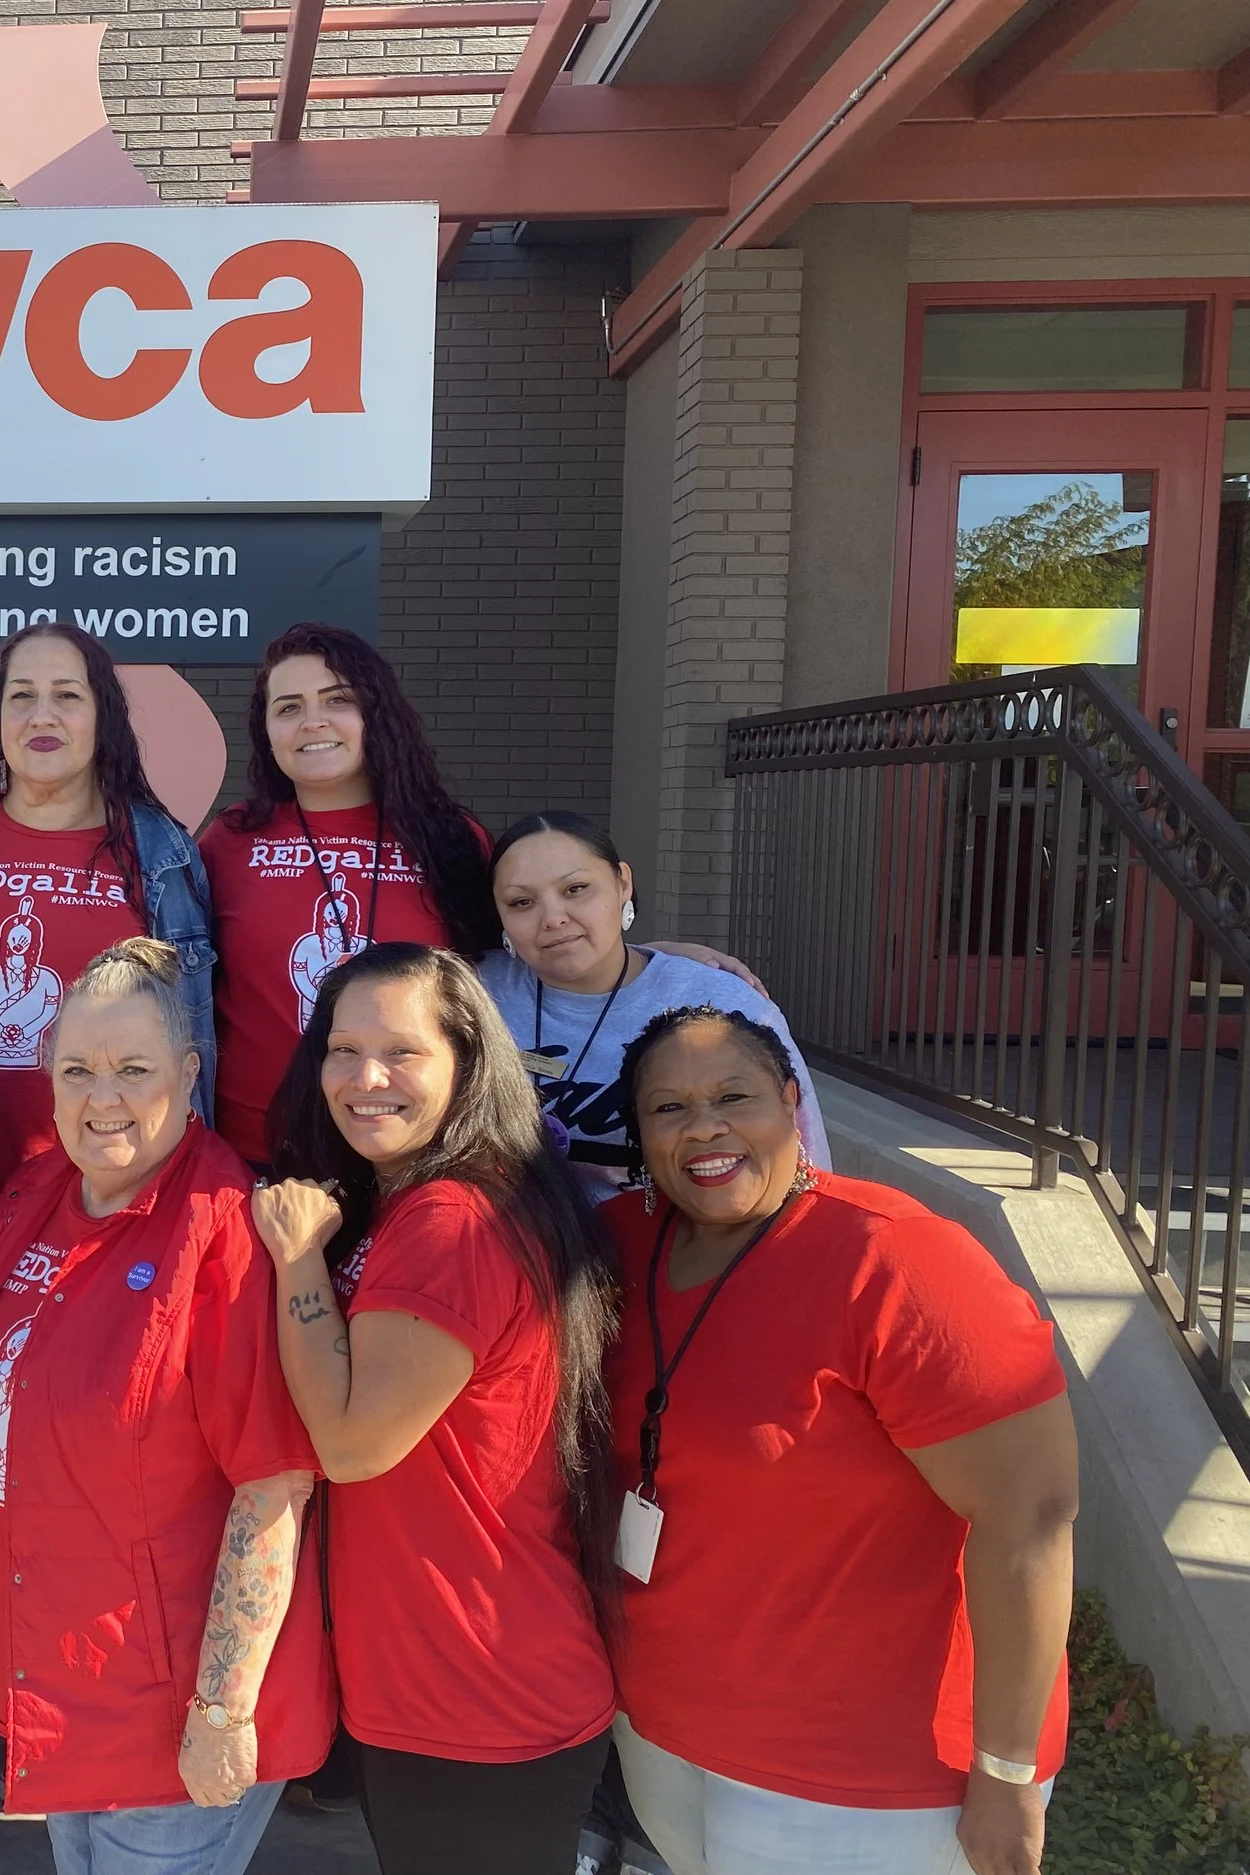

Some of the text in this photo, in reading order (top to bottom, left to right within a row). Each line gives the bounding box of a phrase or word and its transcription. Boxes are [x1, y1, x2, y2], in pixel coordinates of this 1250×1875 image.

[74, 536, 237, 576] racism
[73, 608, 249, 638] women
[319, 836, 349, 845] Victim
[13, 861, 46, 869] Victim
[93, 870, 125, 881] Progra
[260, 867, 305, 878] #MMIP
[51, 894, 118, 907] #MMNWG
[36, 1242, 60, 1257] Nation
